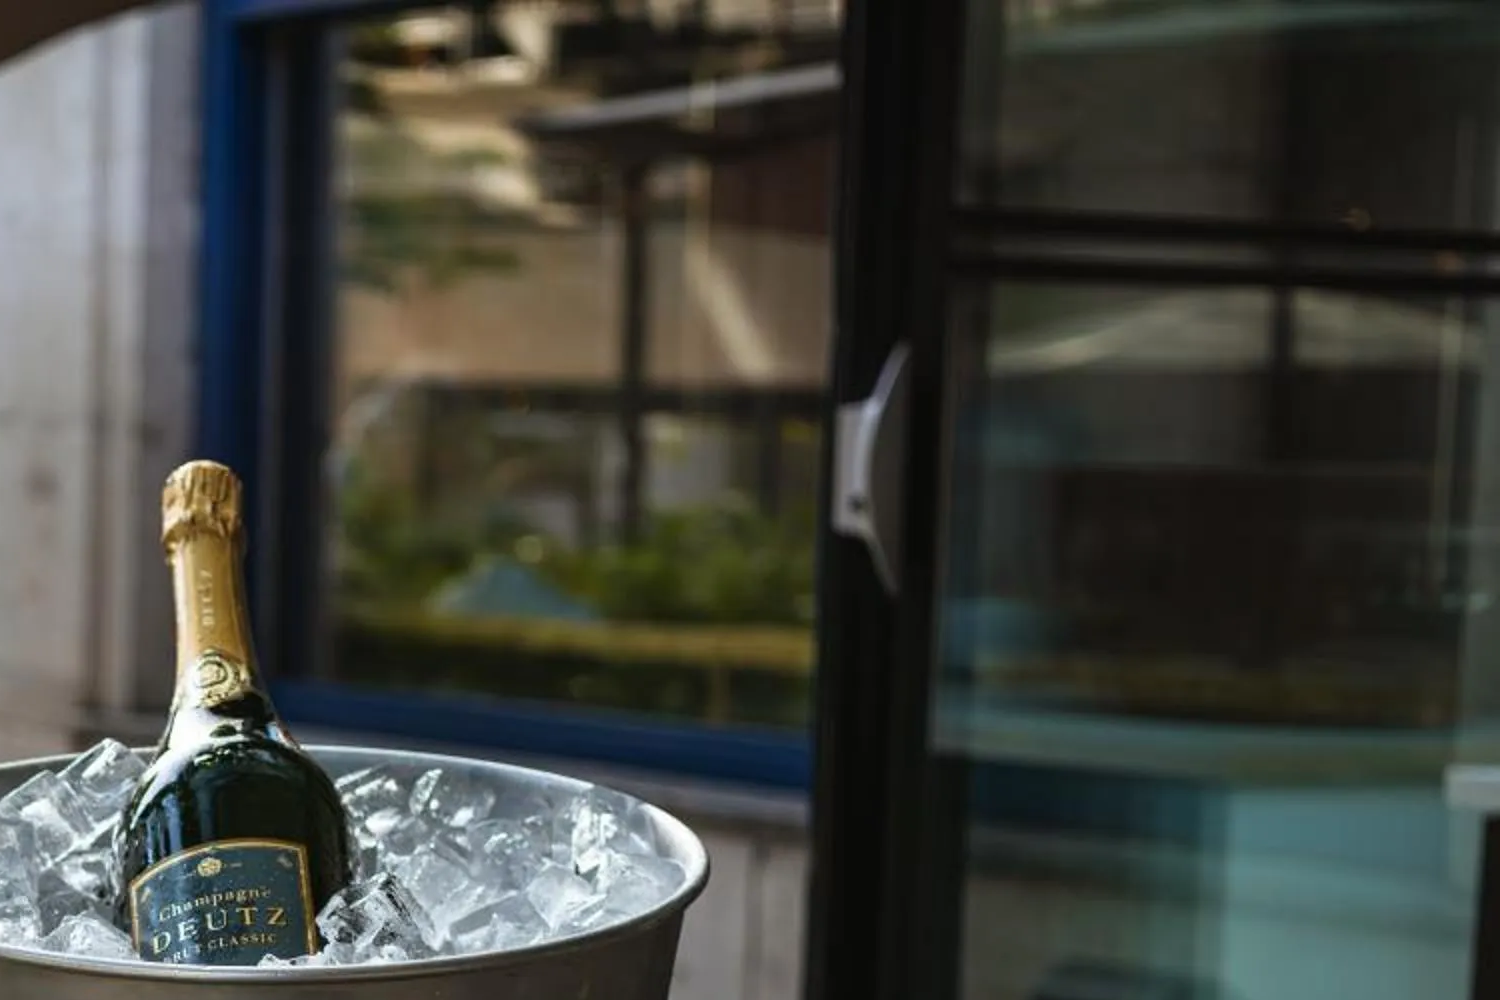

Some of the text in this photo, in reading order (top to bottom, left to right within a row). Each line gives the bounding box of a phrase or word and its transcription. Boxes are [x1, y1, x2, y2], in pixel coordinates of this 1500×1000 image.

[159, 888, 271, 922] Champagne
[152, 906, 287, 955] DEUTZ
[208, 933, 276, 949] CLASSIC
